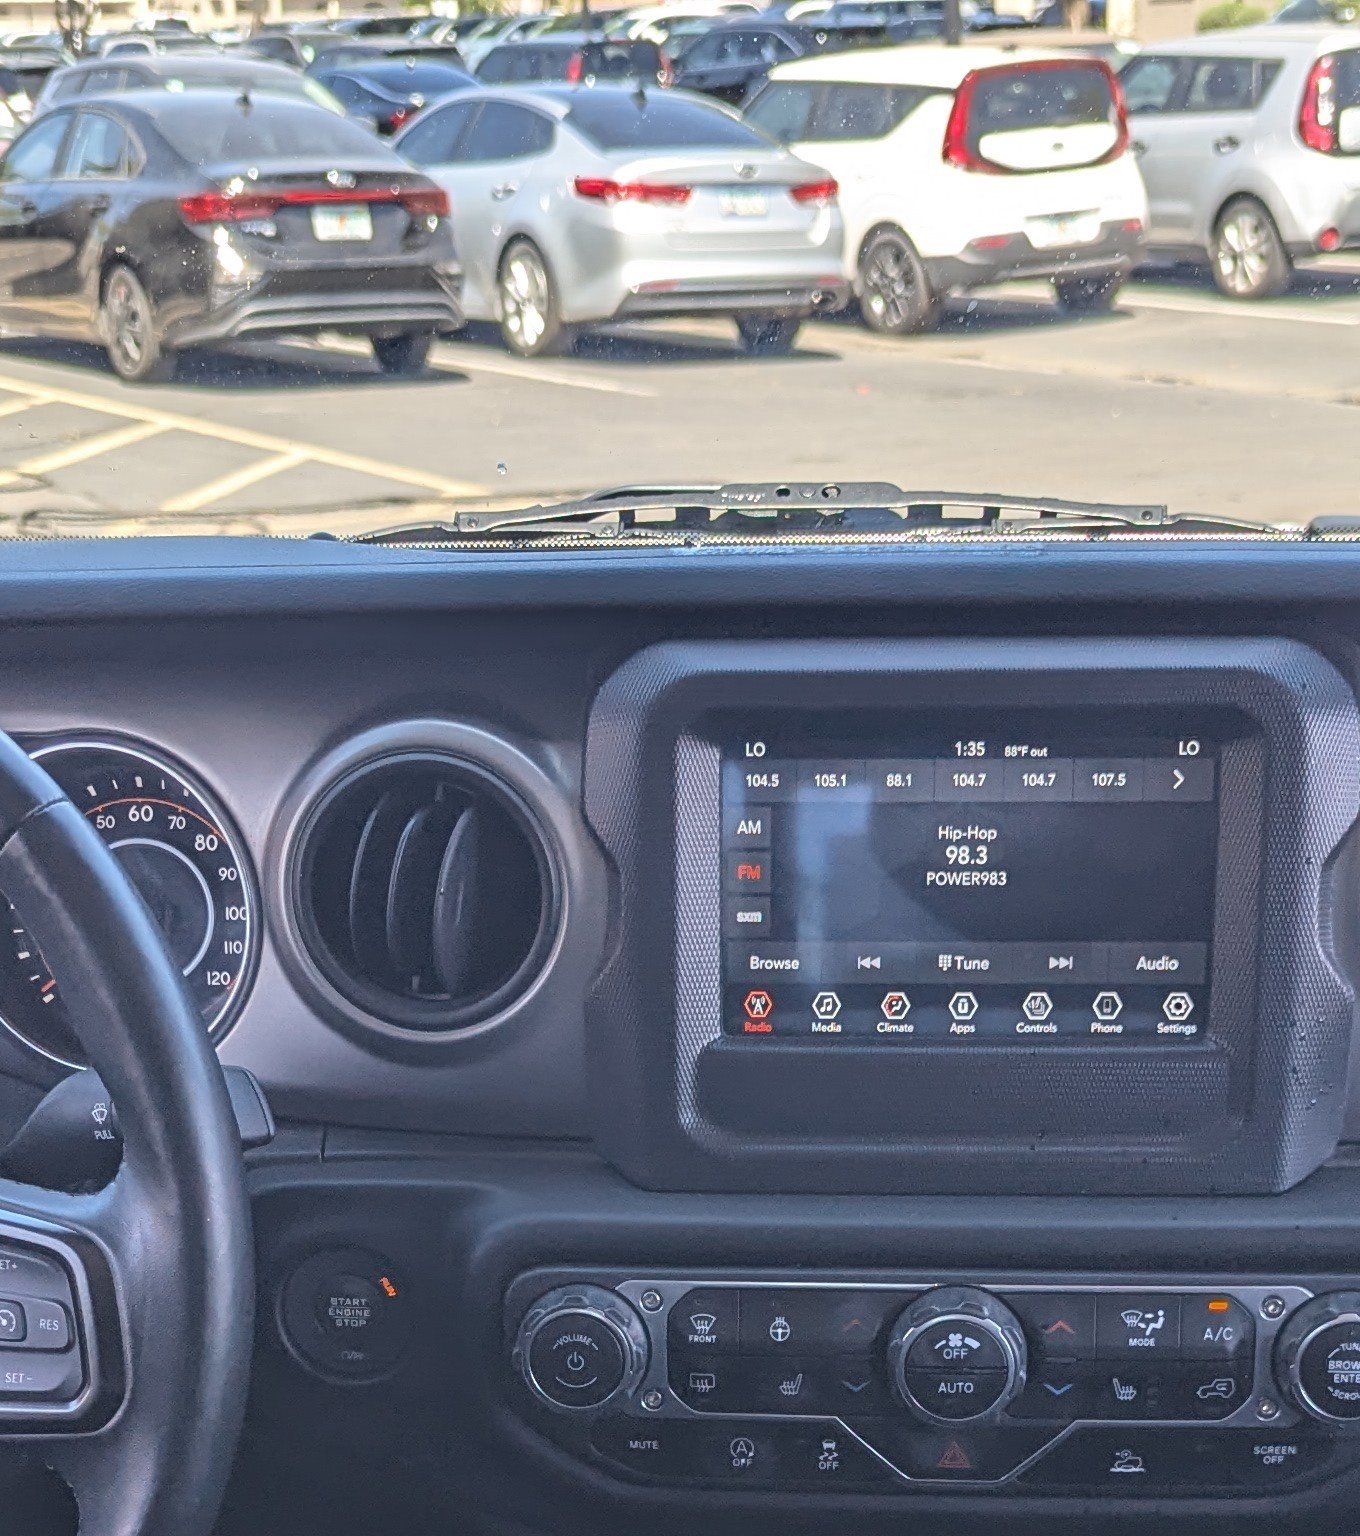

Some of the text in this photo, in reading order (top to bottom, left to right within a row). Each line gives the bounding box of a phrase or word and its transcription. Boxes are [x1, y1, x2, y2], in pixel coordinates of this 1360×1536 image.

[745, 741, 766, 758] LO
[954, 741, 985, 758] 1:35
[1030, 746, 1048, 758] out
[1178, 740, 1200, 757] LO
[745, 773, 780, 788] 104.5
[814, 773, 847, 788] 105.1
[886, 773, 913, 788] 88.1
[952, 772, 987, 788] 104.7
[1022, 772, 1057, 788] 104.7
[1091, 772, 1127, 788] 107.5
[127, 805, 154, 823] 60
[96, 815, 116, 829] 50
[168, 815, 186, 830] 70
[736, 820, 761, 835] AM
[938, 825, 998, 842] Hip-Hop
[194, 834, 218, 852] 80
[945, 845, 988, 866] 98.3
[218, 867, 237, 882] 90
[736, 865, 761, 880] FM
[926, 870, 1008, 886] POWER983
[225, 906, 247, 921] 100
[224, 940, 243, 955] 110
[749, 955, 800, 971] Browse
[953, 955, 990, 971] Tune
[1135, 955, 1180, 971] Audio
[207, 971, 231, 986] 120
[744, 1021, 773, 1034] Radio
[811, 1021, 842, 1034] Media
[876, 1021, 914, 1034] Climate
[949, 1021, 976, 1036] Apps
[1015, 1022, 1058, 1034] Controls
[1090, 1022, 1123, 1034] Phone
[1156, 1022, 1198, 1036] Settings
[94, 1130, 115, 1140] PULL
[330, 1297, 368, 1307] START
[328, 1307, 372, 1317] ENGINE
[39, 1318, 59, 1331] RES
[335, 1318, 367, 1328] STOP
[556, 1333, 594, 1347] VOLUME
[688, 1333, 717, 1344] FRONT
[1203, 1326, 1234, 1342] A/C
[1128, 1337, 1156, 1348] MODE
[942, 1347, 969, 1360] OFF
[937, 1381, 974, 1394] AUTO
[629, 1439, 659, 1451] MUTE
[1253, 1445, 1297, 1456] SCREEN
[732, 1457, 753, 1468] OFF
[818, 1461, 839, 1471] OFF
[1262, 1455, 1285, 1466] OFF
